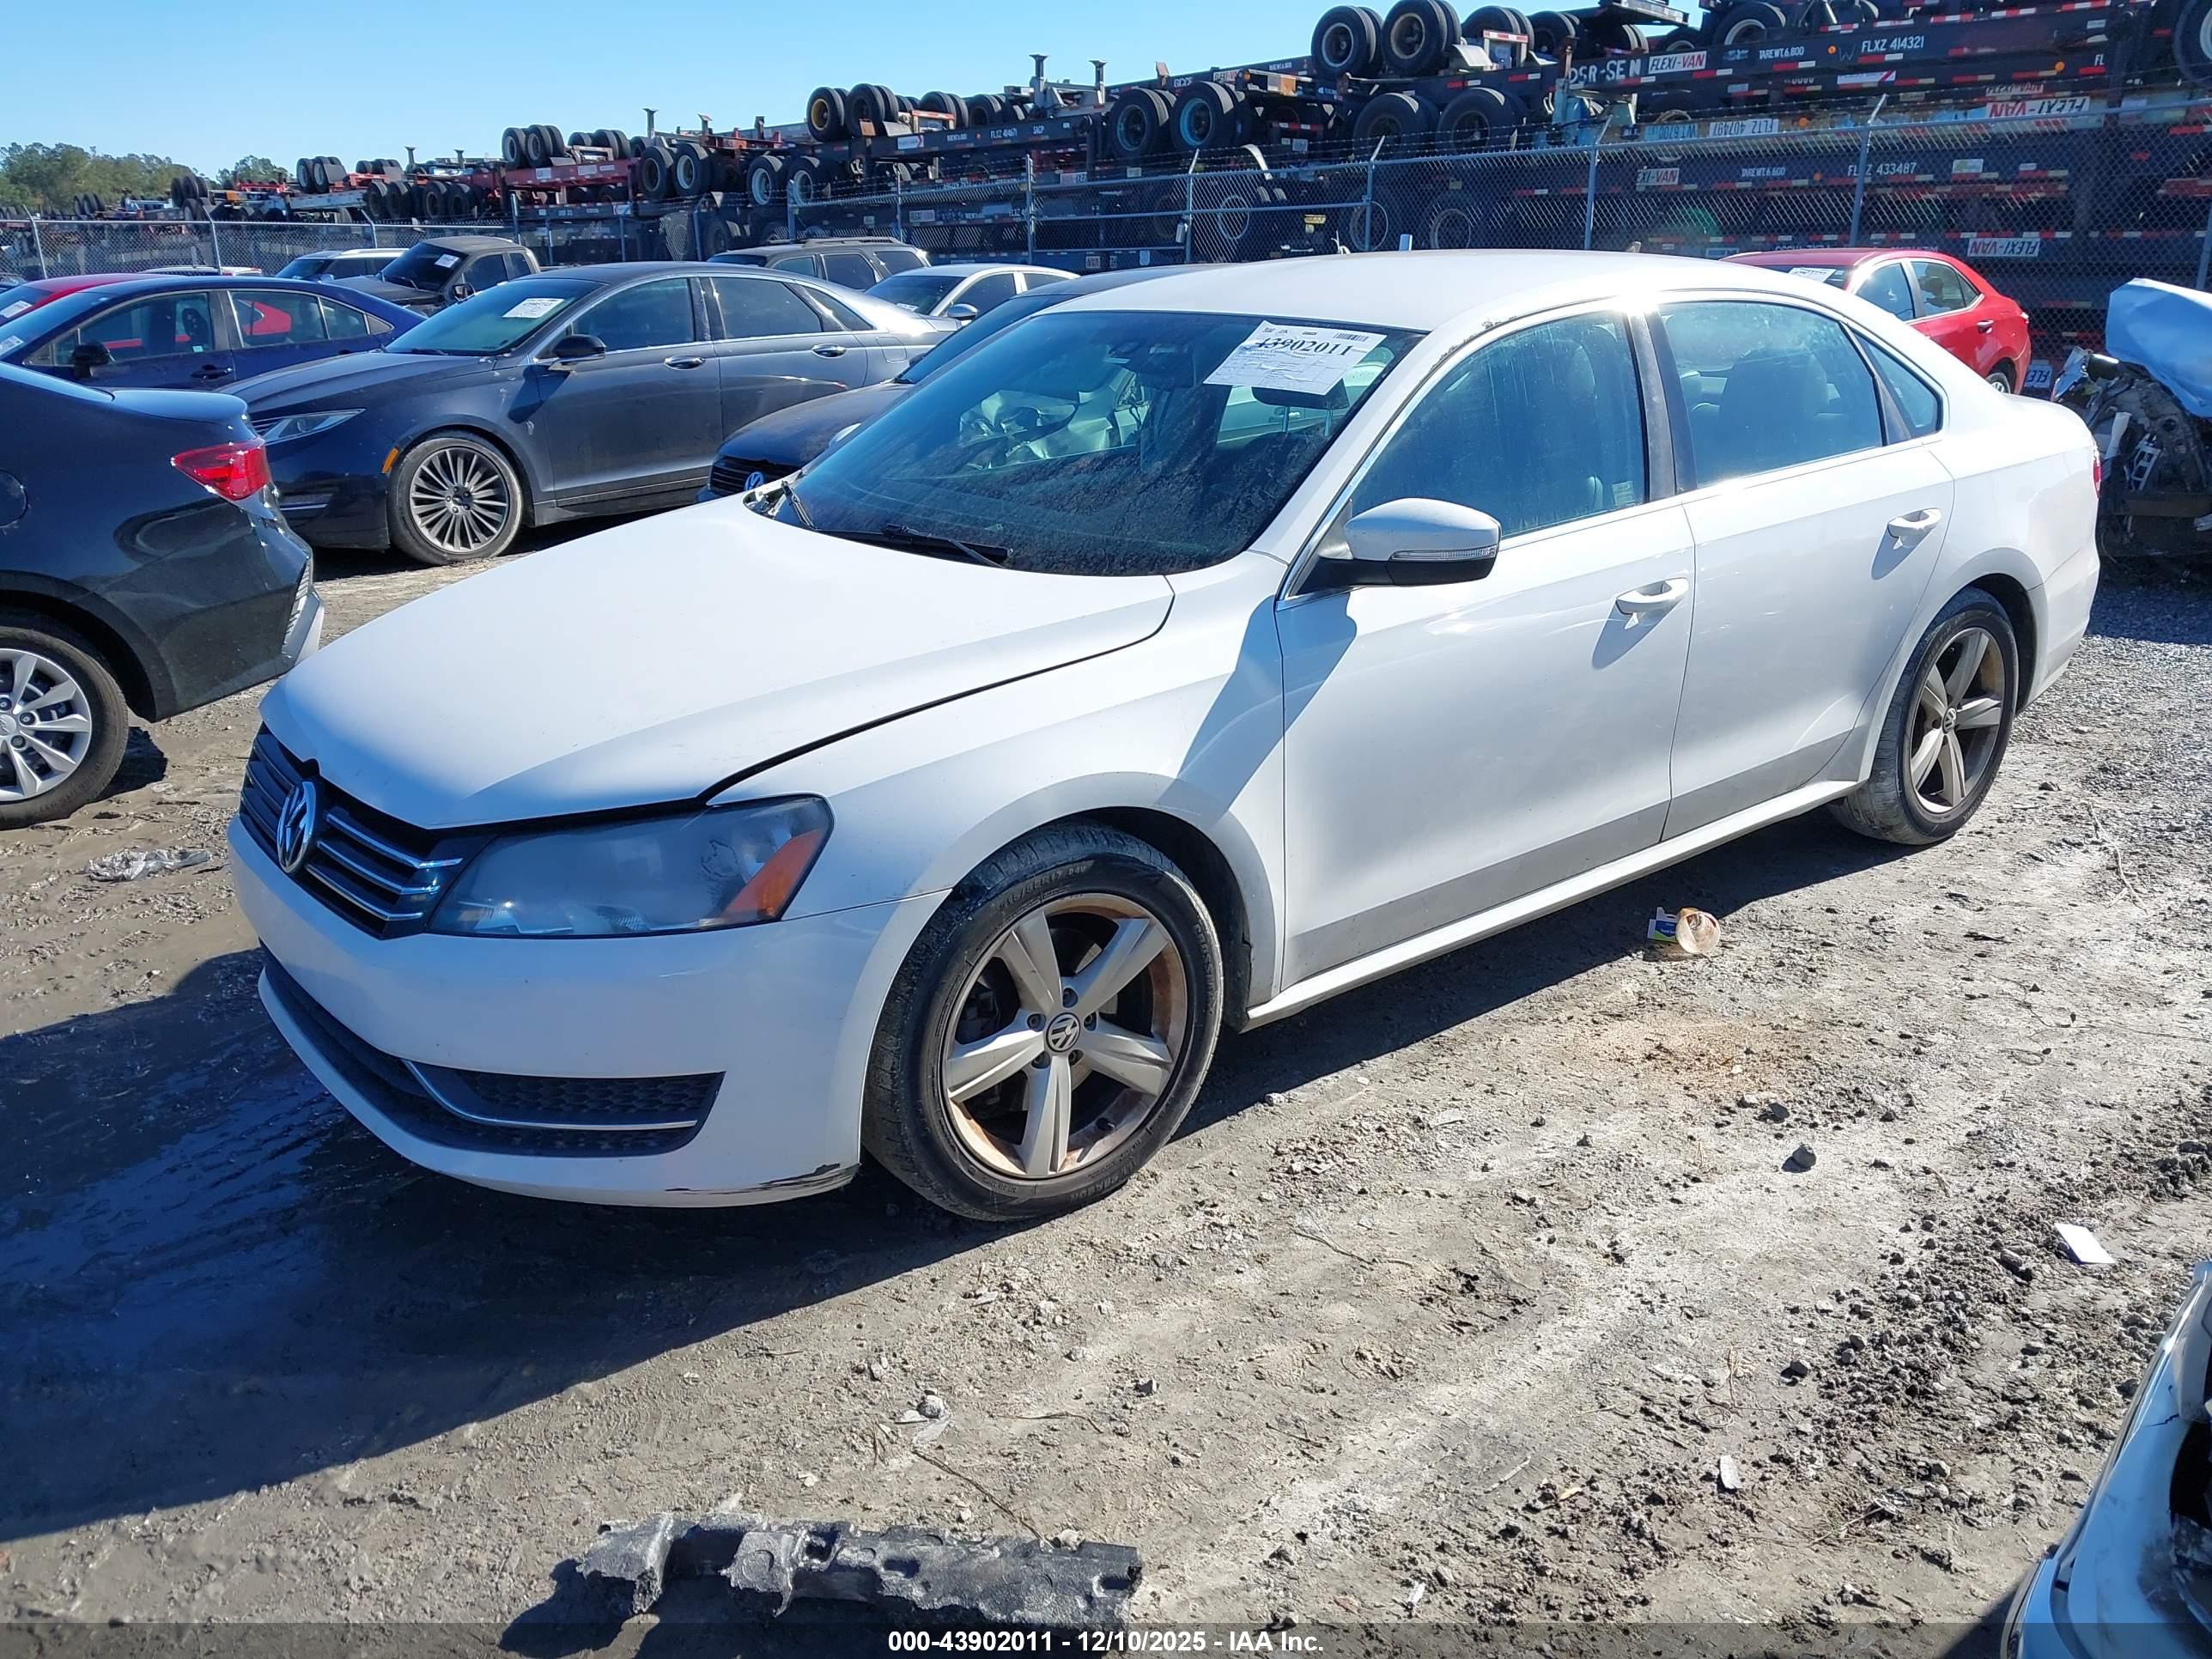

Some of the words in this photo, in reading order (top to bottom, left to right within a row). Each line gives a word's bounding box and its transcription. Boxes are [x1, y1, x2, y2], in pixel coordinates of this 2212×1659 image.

[1862, 40, 1887, 53] FLXZ
[1889, 36, 1924, 51] 414321
[1650, 53, 1705, 71] FLEXI-VAN
[1848, 164, 1872, 177] FLZ
[1876, 161, 1917, 176] 433487
[1970, 240, 2038, 256] FLEXI-VAN
